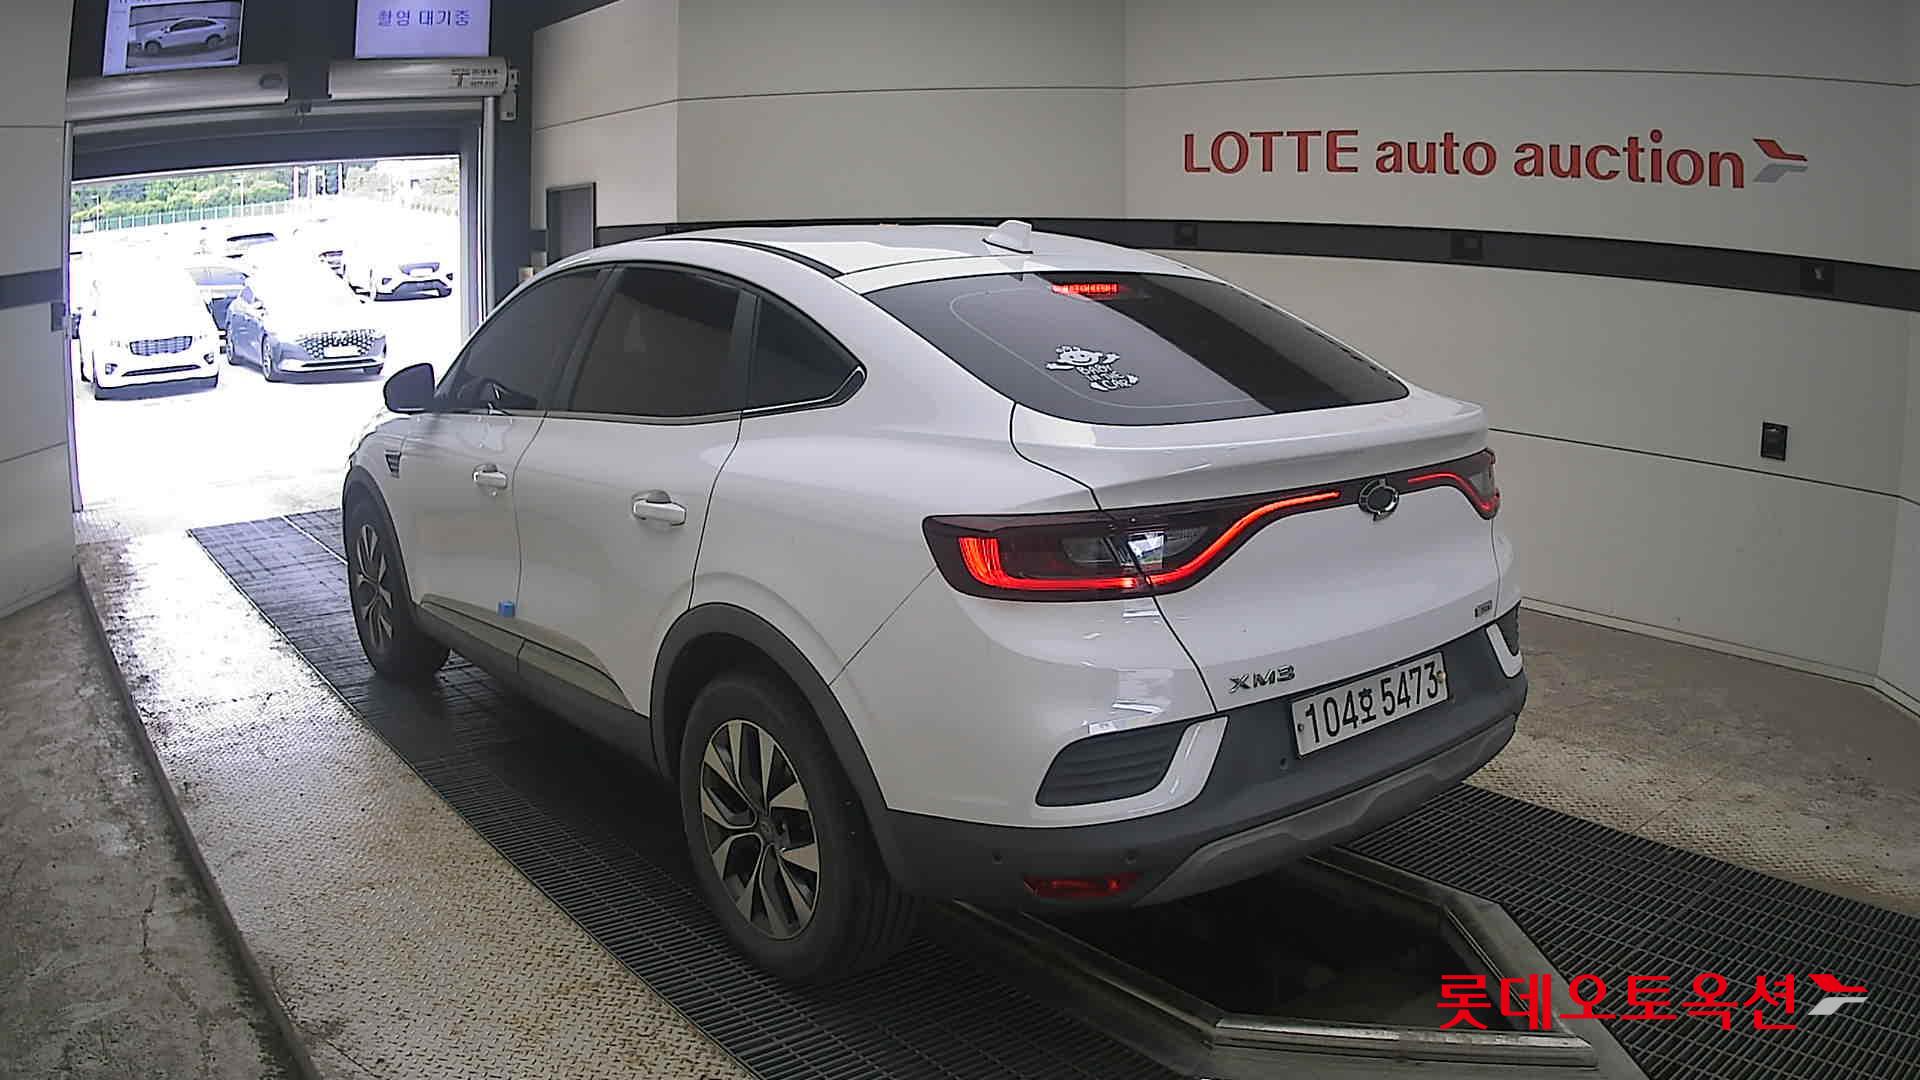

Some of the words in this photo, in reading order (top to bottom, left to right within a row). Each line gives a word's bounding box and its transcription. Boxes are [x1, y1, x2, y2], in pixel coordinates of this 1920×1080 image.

[419, 9, 471, 26] 대기중
[1184, 129, 1359, 174] LOTTE
[1375, 131, 1498, 177] auto
[1513, 128, 1746, 189] auction
[1229, 665, 1296, 693] XM3
[1304, 687, 1377, 744] 104호
[1380, 660, 1440, 718] 5473
